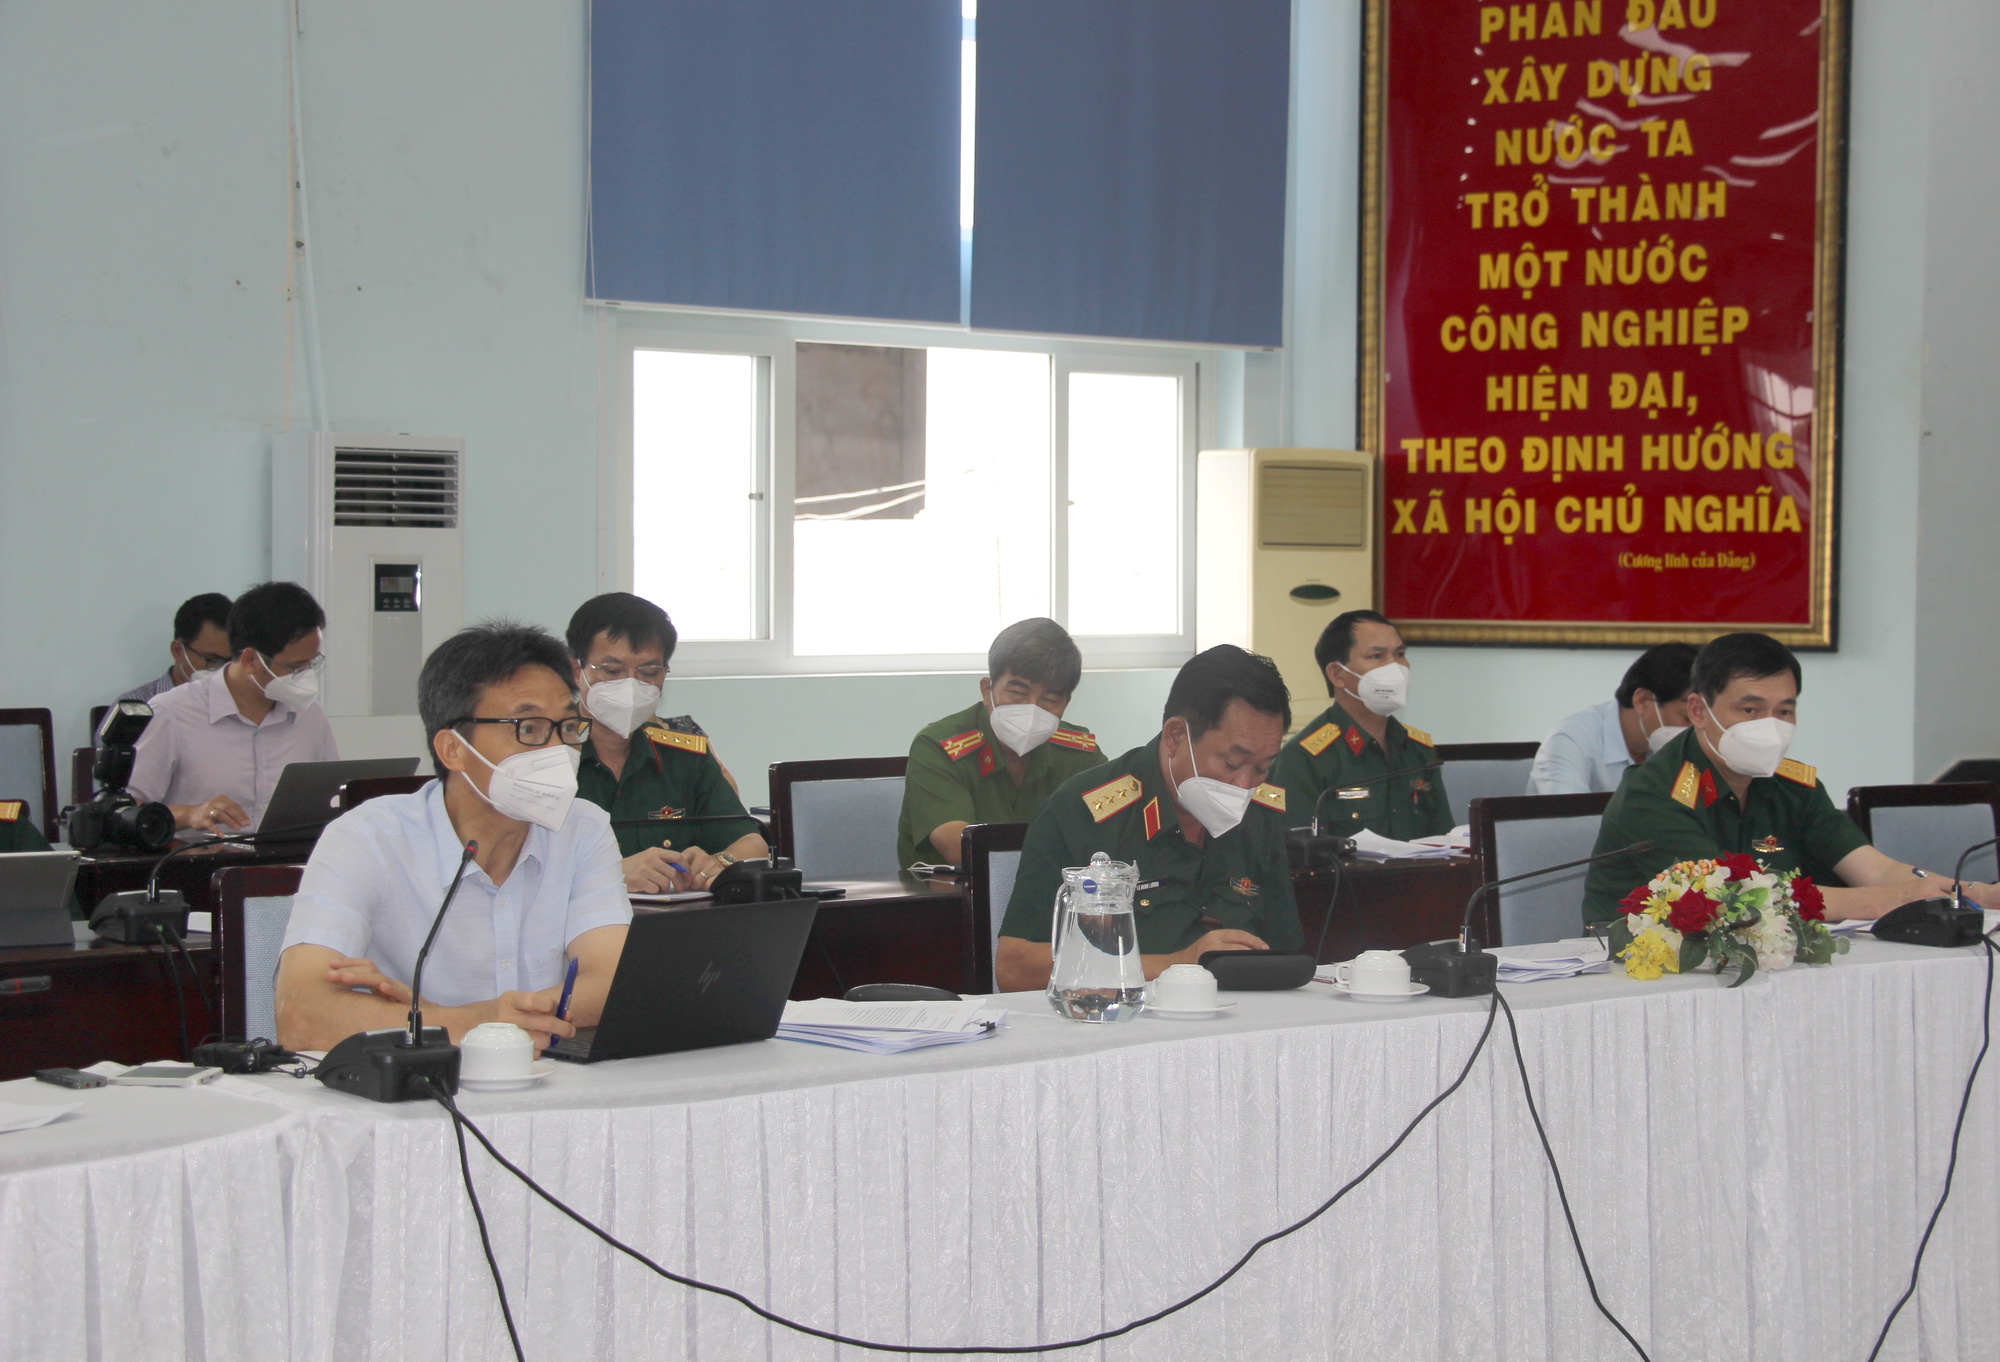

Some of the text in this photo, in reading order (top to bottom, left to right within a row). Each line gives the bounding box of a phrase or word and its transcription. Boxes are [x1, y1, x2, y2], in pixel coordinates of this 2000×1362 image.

[1483, 50, 1711, 107] XÂY DỰNG
[1496, 114, 1693, 165] NƯỚC TA
[1465, 174, 1726, 228] TRỞ THÀNH
[1480, 235, 1707, 299] MỘT NƯỚC
[1441, 298, 1748, 355] CÔNG NGHIỆP
[1487, 366, 1697, 421] HIỆN ĐẠI,
[1401, 422, 1794, 482] THEO ĐỊNH HƯỚNG
[1393, 483, 1801, 545] XÃ HỘI CHỦ NGHĨA
